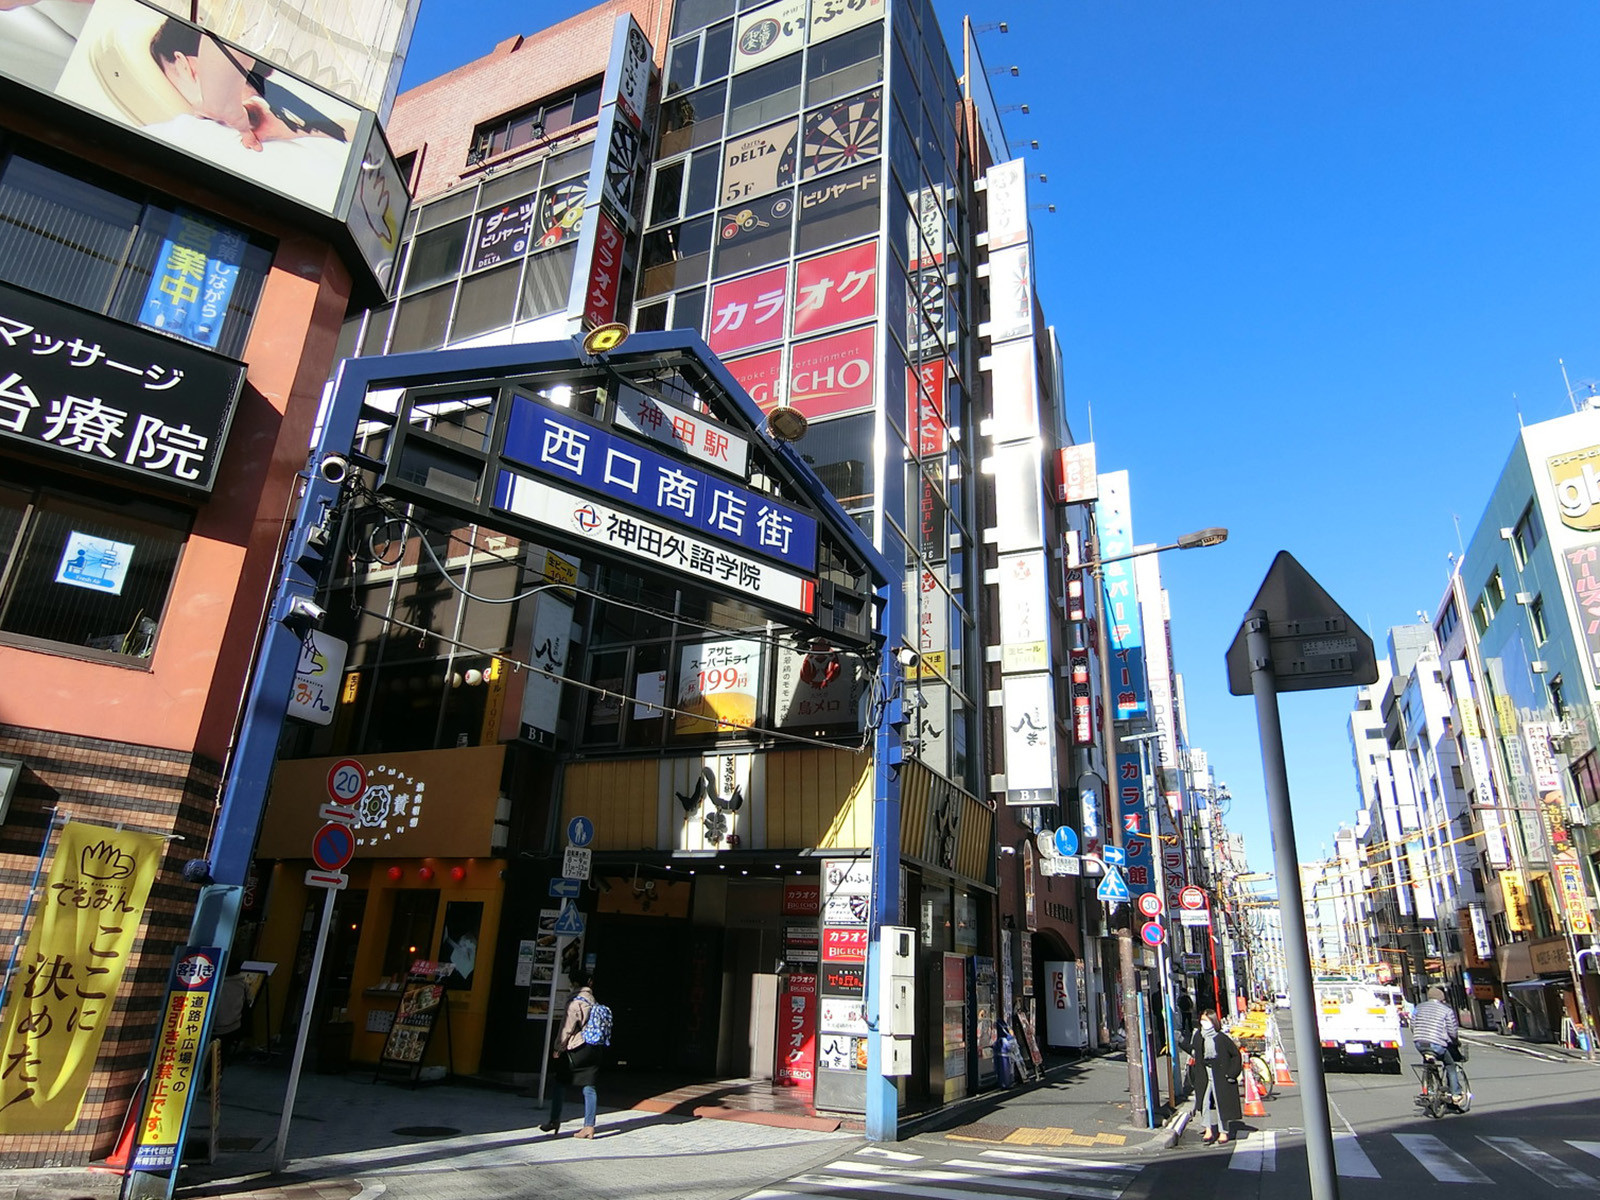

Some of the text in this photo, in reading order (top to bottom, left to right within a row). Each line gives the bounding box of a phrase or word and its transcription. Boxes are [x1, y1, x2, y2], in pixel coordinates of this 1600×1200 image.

[730, 143, 777, 167] DELTA
[803, 174, 877, 209] ビリヤード
[478, 256, 501, 267] DELTA
[592, 225, 618, 309] カラオケ
[712, 268, 875, 335] カラオケ
[0, 317, 184, 391] マッサージ
[771, 347, 860, 376] Enertainment
[637, 400, 729, 462] 神田駅
[541, 418, 793, 555] 西口商店街
[606, 513, 761, 592] 神田外語学院
[548, 556, 574, 577] 生ビール
[690, 654, 750, 669] スーパードライ
[708, 646, 732, 657] アサヒ
[528, 727, 544, 744] B1
[335, 771, 360, 794] 20
[1020, 790, 1041, 801] B1
[1121, 763, 1148, 885] カラオケ館
[51, 883, 134, 912] てもみん
[787, 891, 818, 899] カラオケ
[1144, 899, 1157, 910] 30
[830, 932, 867, 942] カラオケ
[829, 947, 846, 957] BIG
[66, 926, 123, 1032] ここに
[176, 962, 214, 977] 客引き
[1056, 971, 1065, 1010] DyDo
[172, 996, 204, 1092] 道路や広場での
[146, 996, 188, 1140] 客引きは禁止です。
[780, 1069, 811, 1079] BIG ECHO
